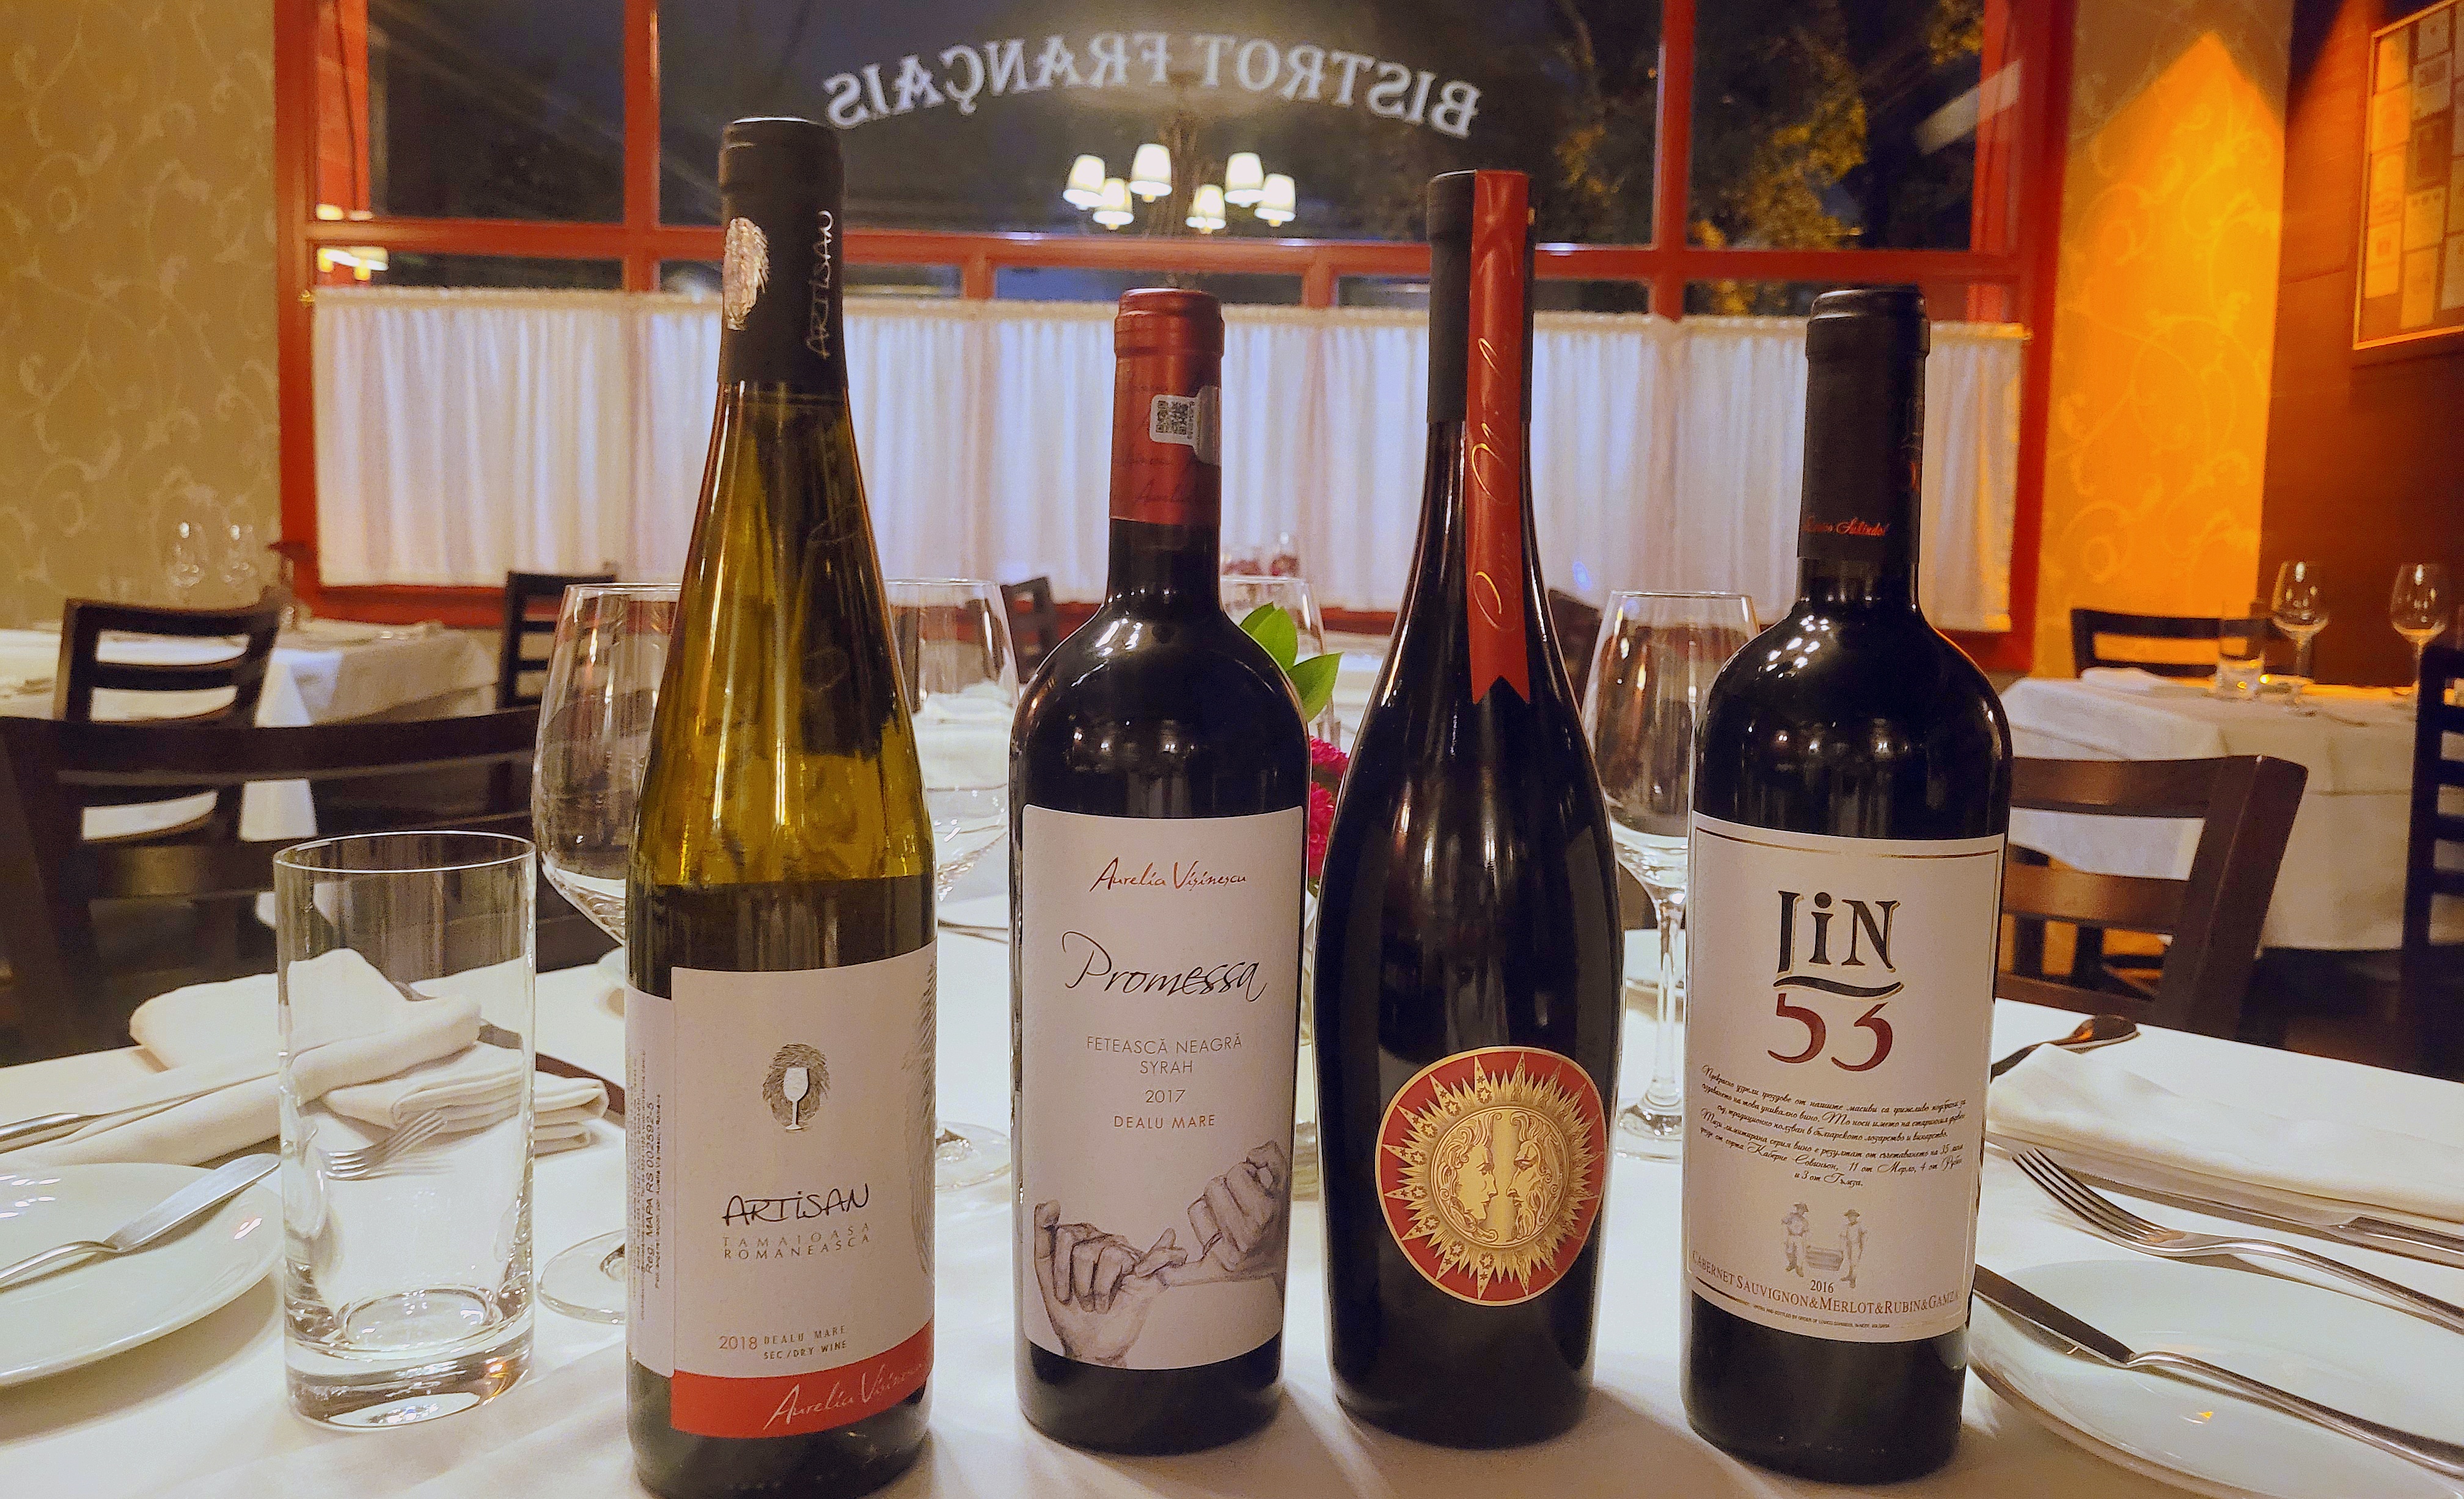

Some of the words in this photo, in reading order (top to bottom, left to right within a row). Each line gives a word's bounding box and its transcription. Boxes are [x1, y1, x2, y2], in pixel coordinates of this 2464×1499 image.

[1089, 857, 1167, 892] Aurelia
[1062, 931, 1268, 1002] Promessa
[1767, 992, 1893, 1072] 53
[1087, 1036, 1168, 1055] FETEASCĂ
[1176, 1032, 1242, 1054] NEAGRĂ
[1139, 1060, 1193, 1074] SYRAH
[1145, 1089, 1186, 1104] 2017
[1742, 1099, 1759, 1110] това
[1810, 1101, 1844, 1111] нашите
[1846, 1103, 1877, 1113] масиви
[1113, 1115, 1164, 1129] DEALU
[1172, 1113, 1216, 1129] MARE
[1793, 1140, 1812, 1152] вино
[645, 1172, 654, 1193] RS
[645, 1198, 654, 1237] MAPA
[1809, 1278, 1835, 1294] 2016
[719, 1335, 758, 1350] 2018
[764, 1332, 804, 1345] DEALU
[813, 1325, 846, 1338] MARE
[820, 1340, 848, 1354] WINE
[763, 1383, 854, 1431] Aurelia
